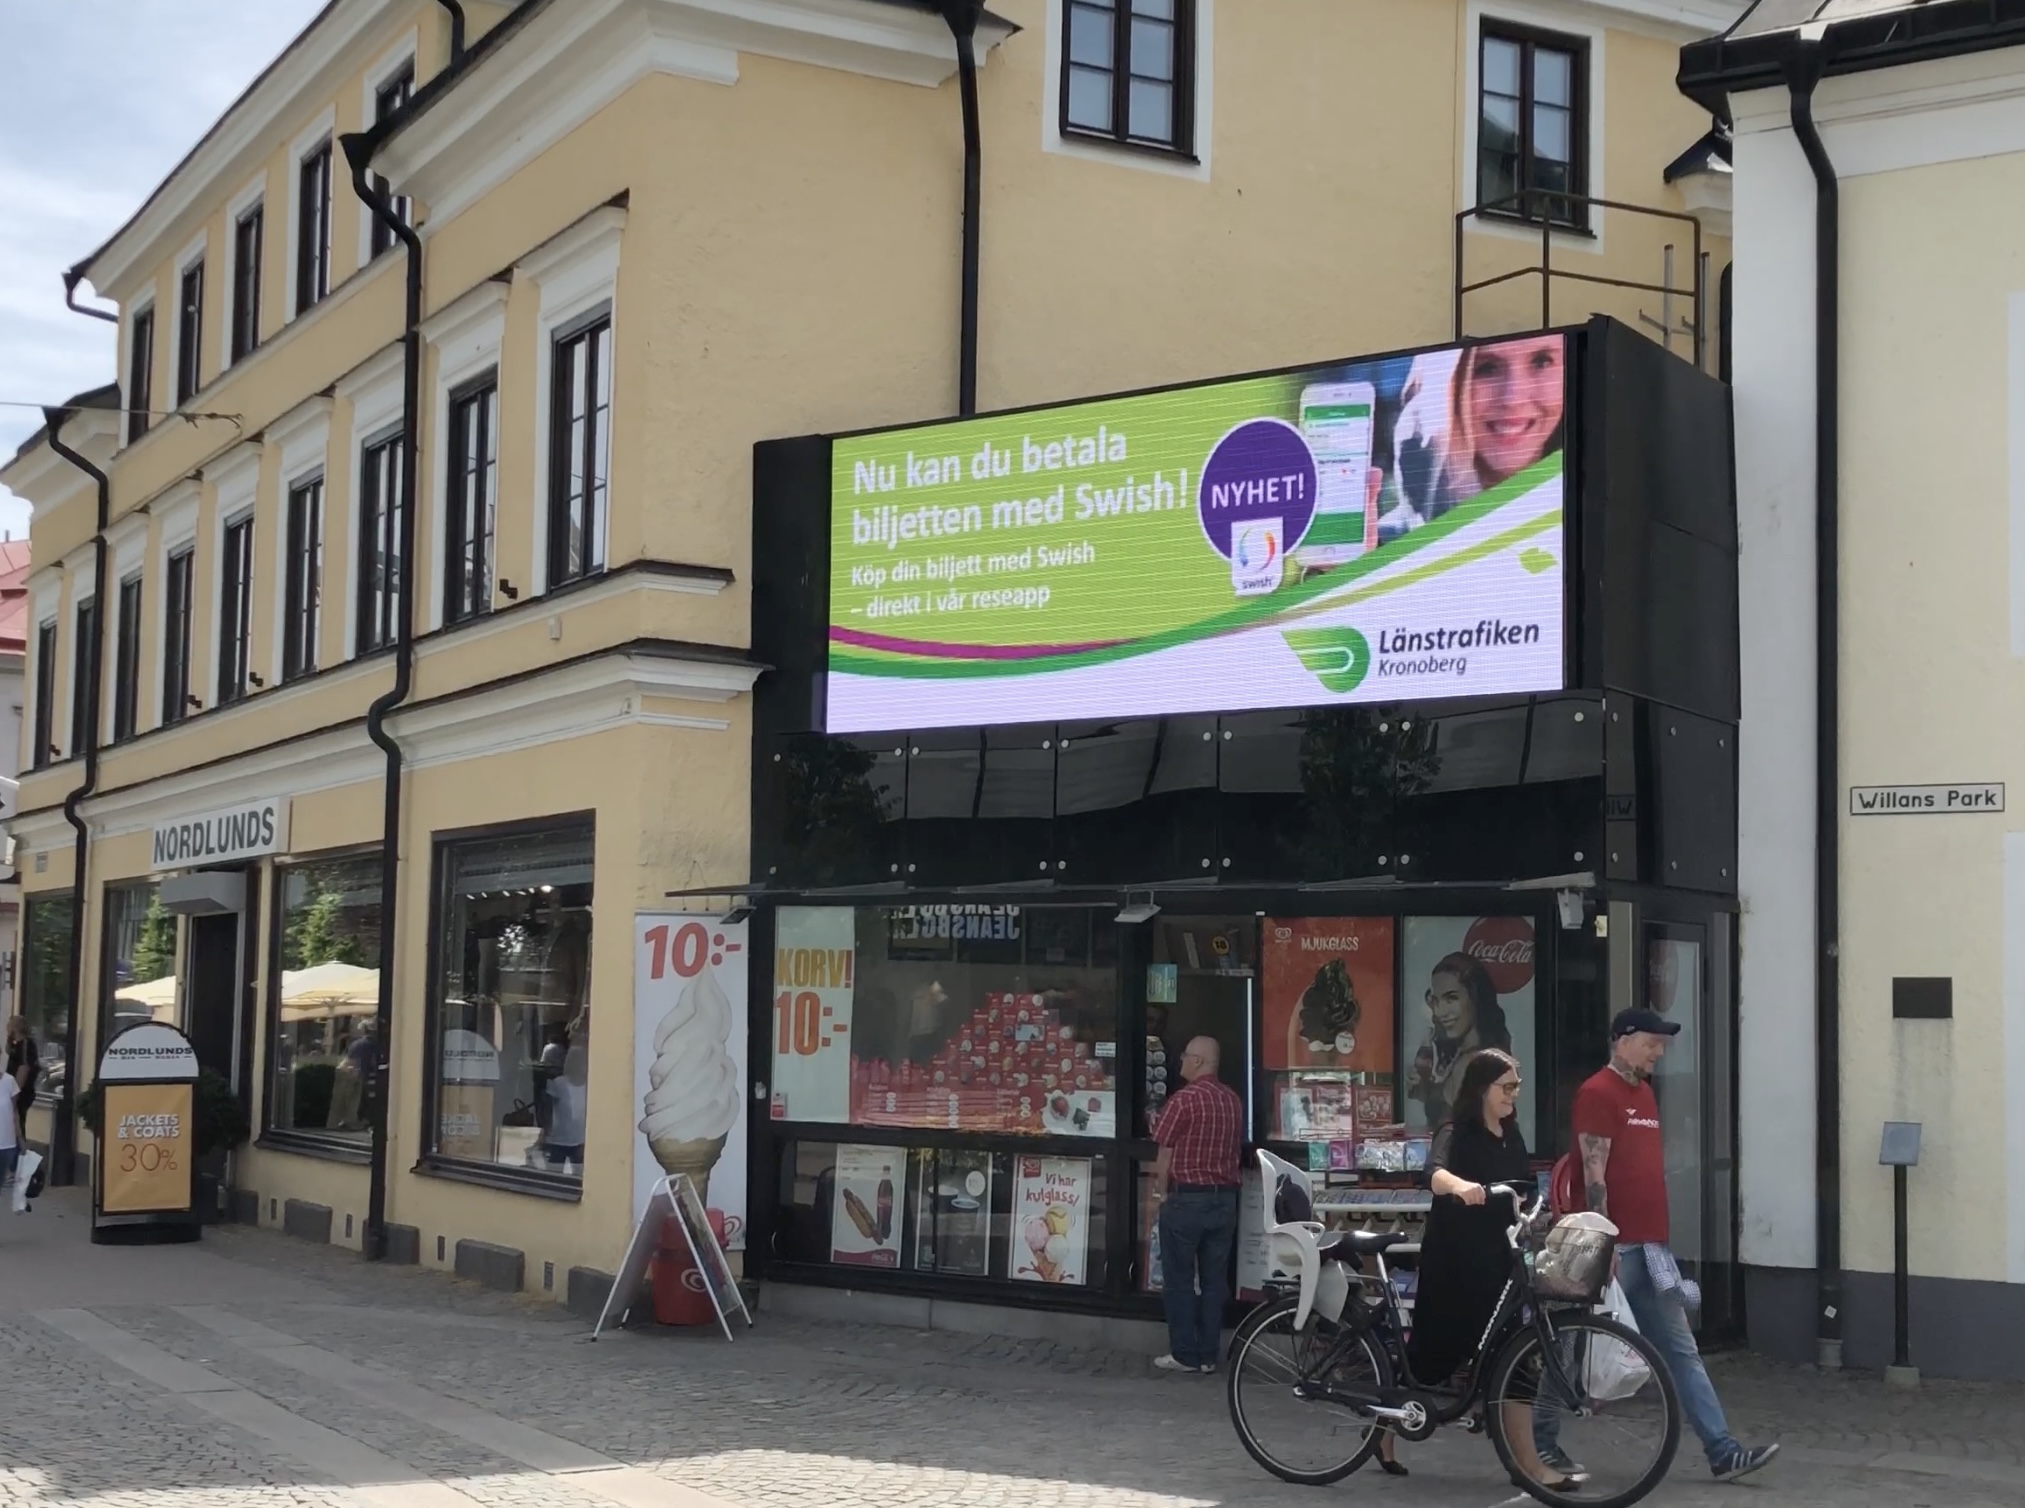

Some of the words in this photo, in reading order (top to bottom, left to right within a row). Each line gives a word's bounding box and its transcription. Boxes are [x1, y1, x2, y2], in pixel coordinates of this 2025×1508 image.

[854, 459, 896, 495] Nu
[906, 451, 961, 488] kan
[971, 441, 1012, 480] du
[1022, 424, 1127, 474] betala
[1212, 472, 1305, 510] NYHET!
[852, 505, 982, 550] biljetten
[992, 484, 1064, 529] med
[1075, 467, 1188, 521] Swish!
[852, 566, 887, 588] Köp
[892, 560, 921, 582] din
[927, 553, 982, 582] biljett
[988, 547, 1032, 573] med
[1037, 540, 1096, 567] Swish
[1242, 576, 1272, 589] swish
[867, 595, 922, 618] direkt
[926, 591, 932, 613] i
[937, 587, 967, 612] vår
[973, 585, 1051, 609] reseapp
[1379, 619, 1540, 654] Länstrafiken
[1378, 656, 1467, 676] Kronoberg
[1859, 791, 1935, 809] Willans
[1947, 789, 1997, 807] Park
[153, 806, 275, 864] NORDLUNDS
[644, 922, 742, 980] 10:-
[1301, 936, 1360, 951] MJUKGLASS
[776, 948, 853, 989] KORV!
[776, 991, 848, 1056] 10:-
[108, 1047, 193, 1056] NORDLUNDS
[117, 1127, 129, 1139] &
[134, 1126, 181, 1138] COATS
[119, 1113, 180, 1127] JACKETS
[120, 1143, 179, 1172] 30%
[1045, 1173, 1056, 1185] Vi
[1058, 1174, 1077, 1187] har
